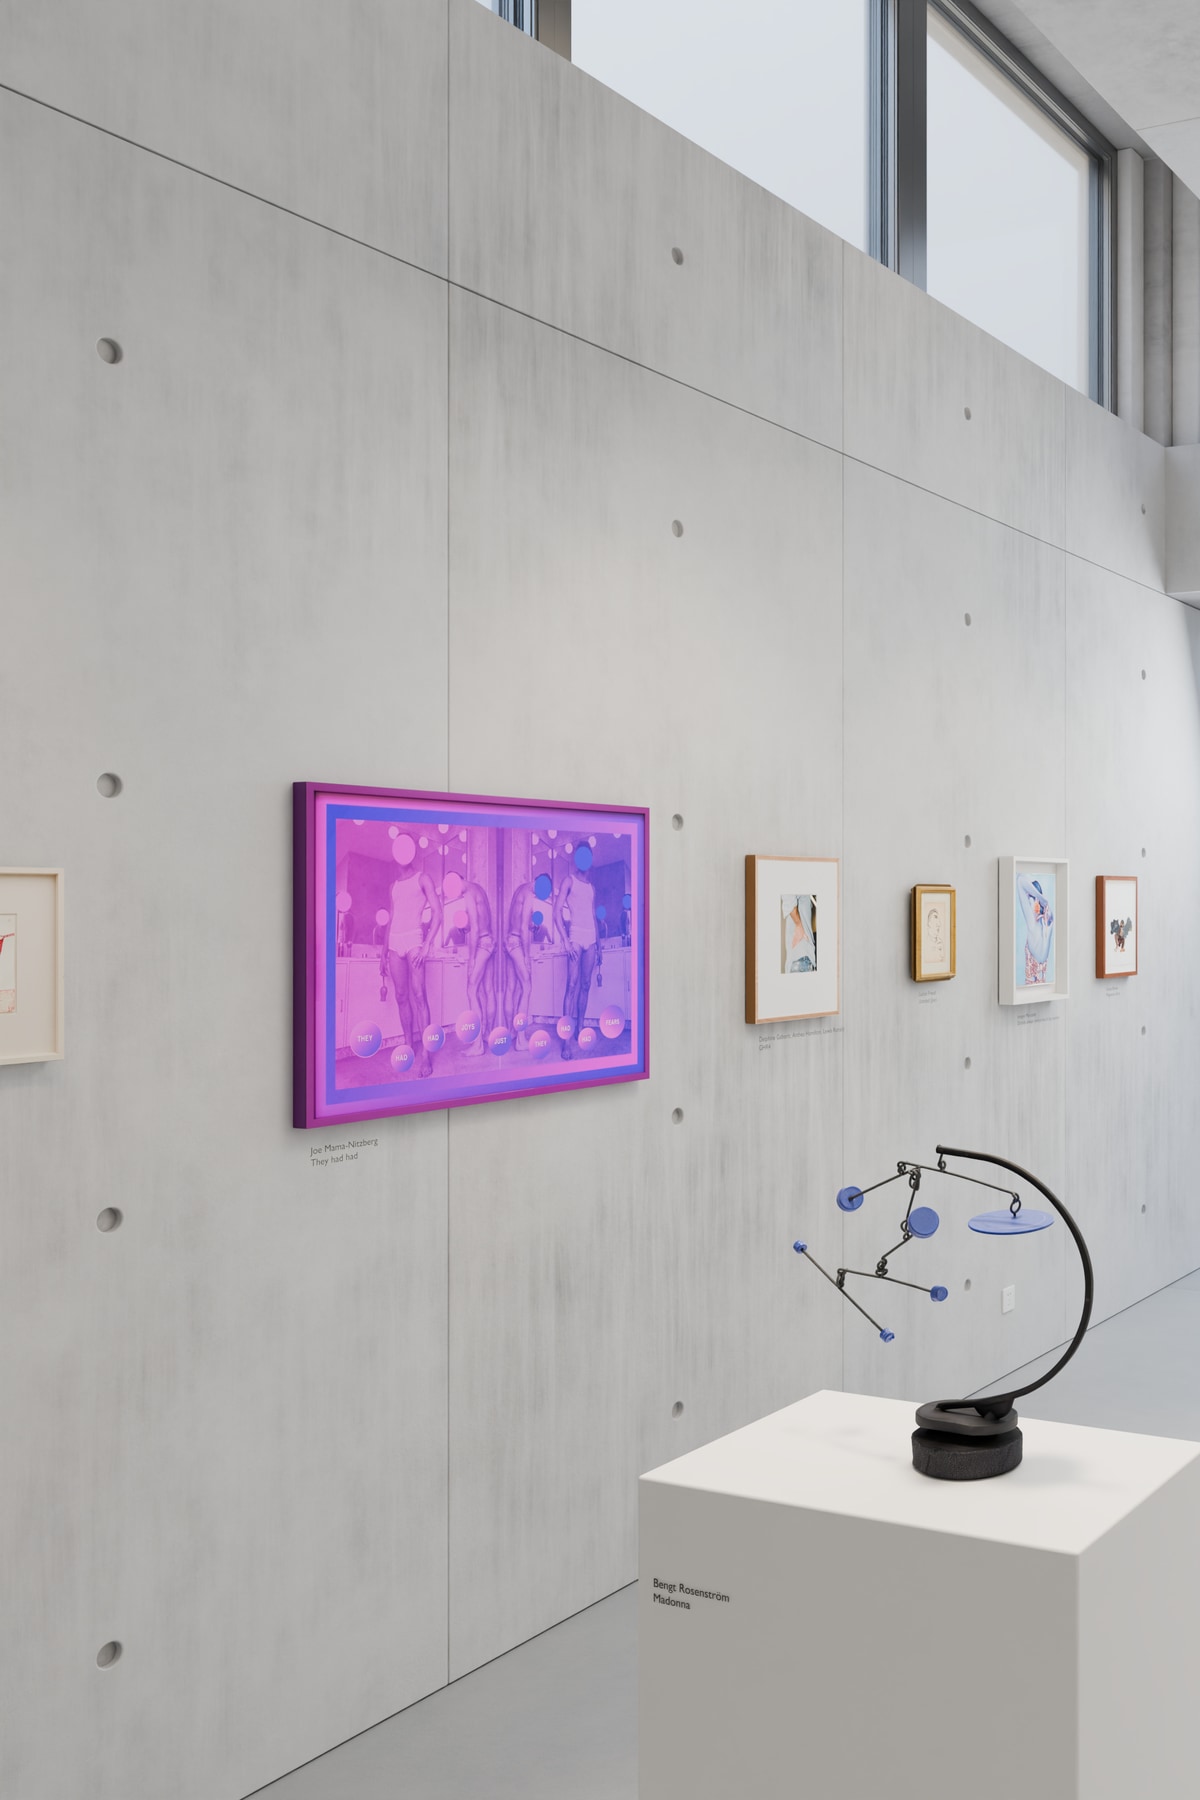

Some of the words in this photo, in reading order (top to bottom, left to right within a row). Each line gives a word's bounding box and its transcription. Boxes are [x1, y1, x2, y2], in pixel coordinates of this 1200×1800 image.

[461, 1023, 475, 1031] JOYS
[494, 1036, 507, 1045] JUST
[535, 1039, 547, 1047] THEY
[310, 1147, 322, 1157] Joe
[324, 1138, 379, 1152] Mama-Nitzberg
[311, 1158, 329, 1167] They
[331, 1154, 343, 1163] had
[345, 1152, 358, 1160] had
[653, 1577, 677, 1594] Bengt
[679, 1583, 730, 1603] Rosenström
[653, 1593, 691, 1610] Madonna
